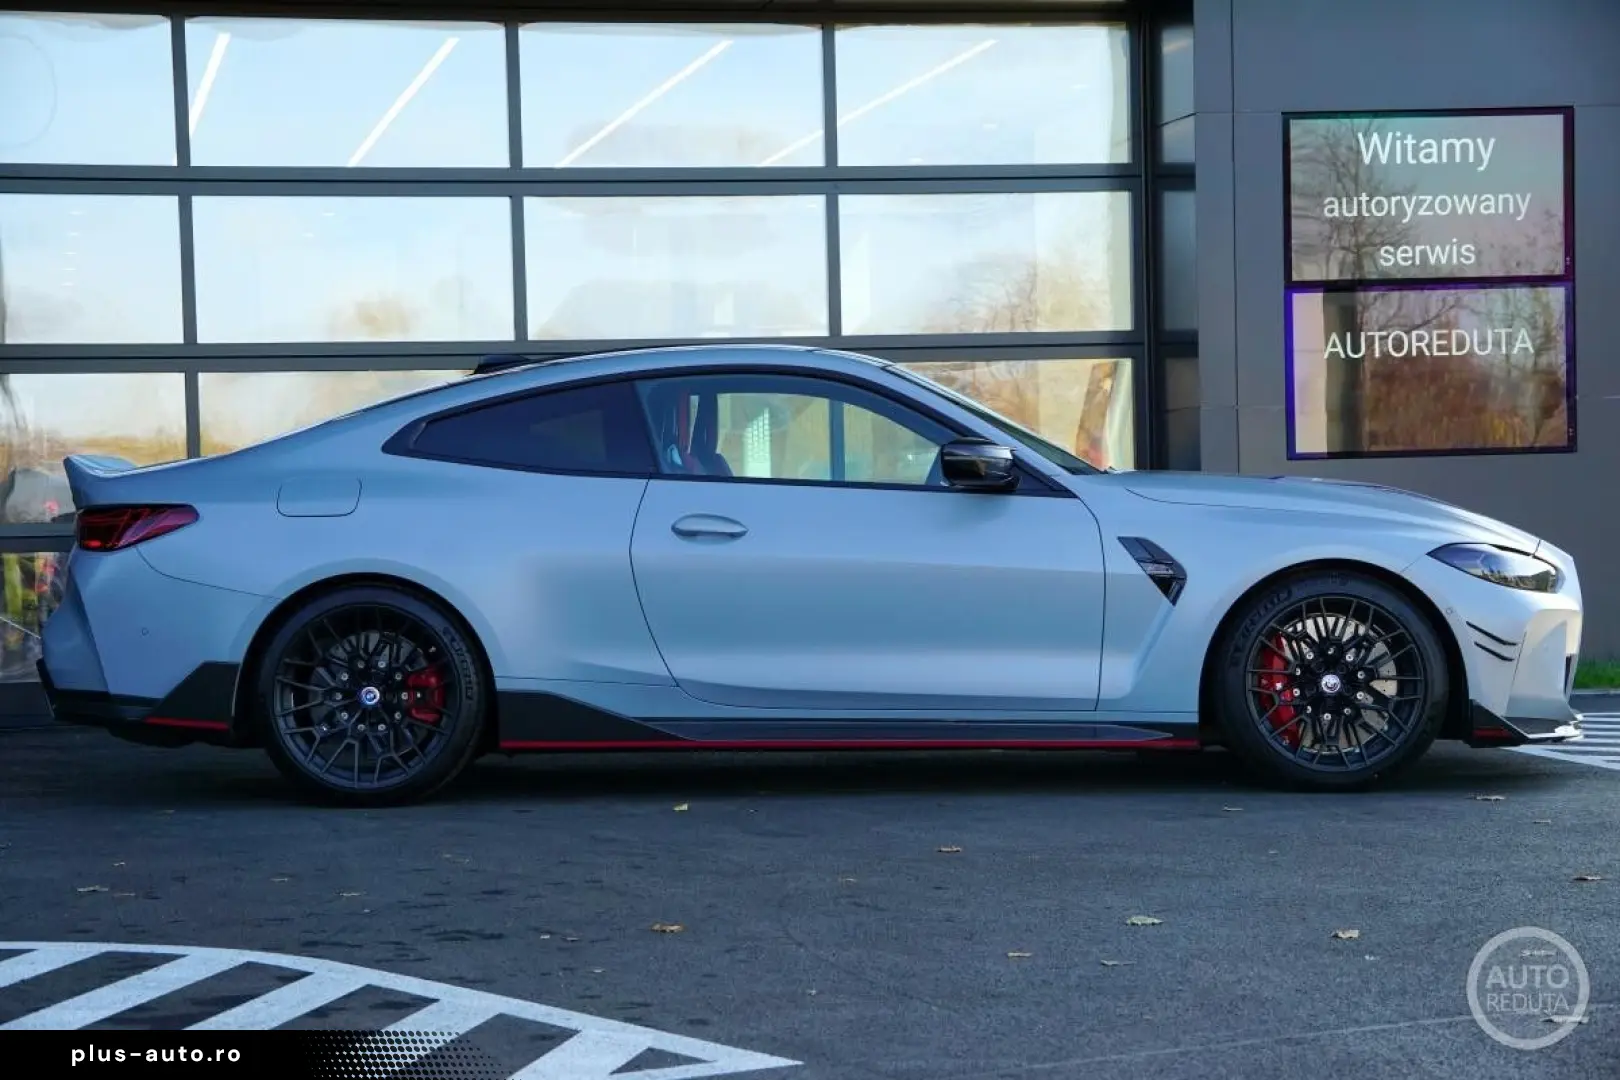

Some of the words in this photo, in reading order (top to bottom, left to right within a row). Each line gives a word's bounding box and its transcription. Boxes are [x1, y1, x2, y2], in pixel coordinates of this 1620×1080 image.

[1358, 131, 1495, 171] Witamy
[1323, 191, 1531, 223] autoryzowany
[1379, 238, 1475, 267] serwis
[1323, 328, 1534, 359] AUTOREDUTA
